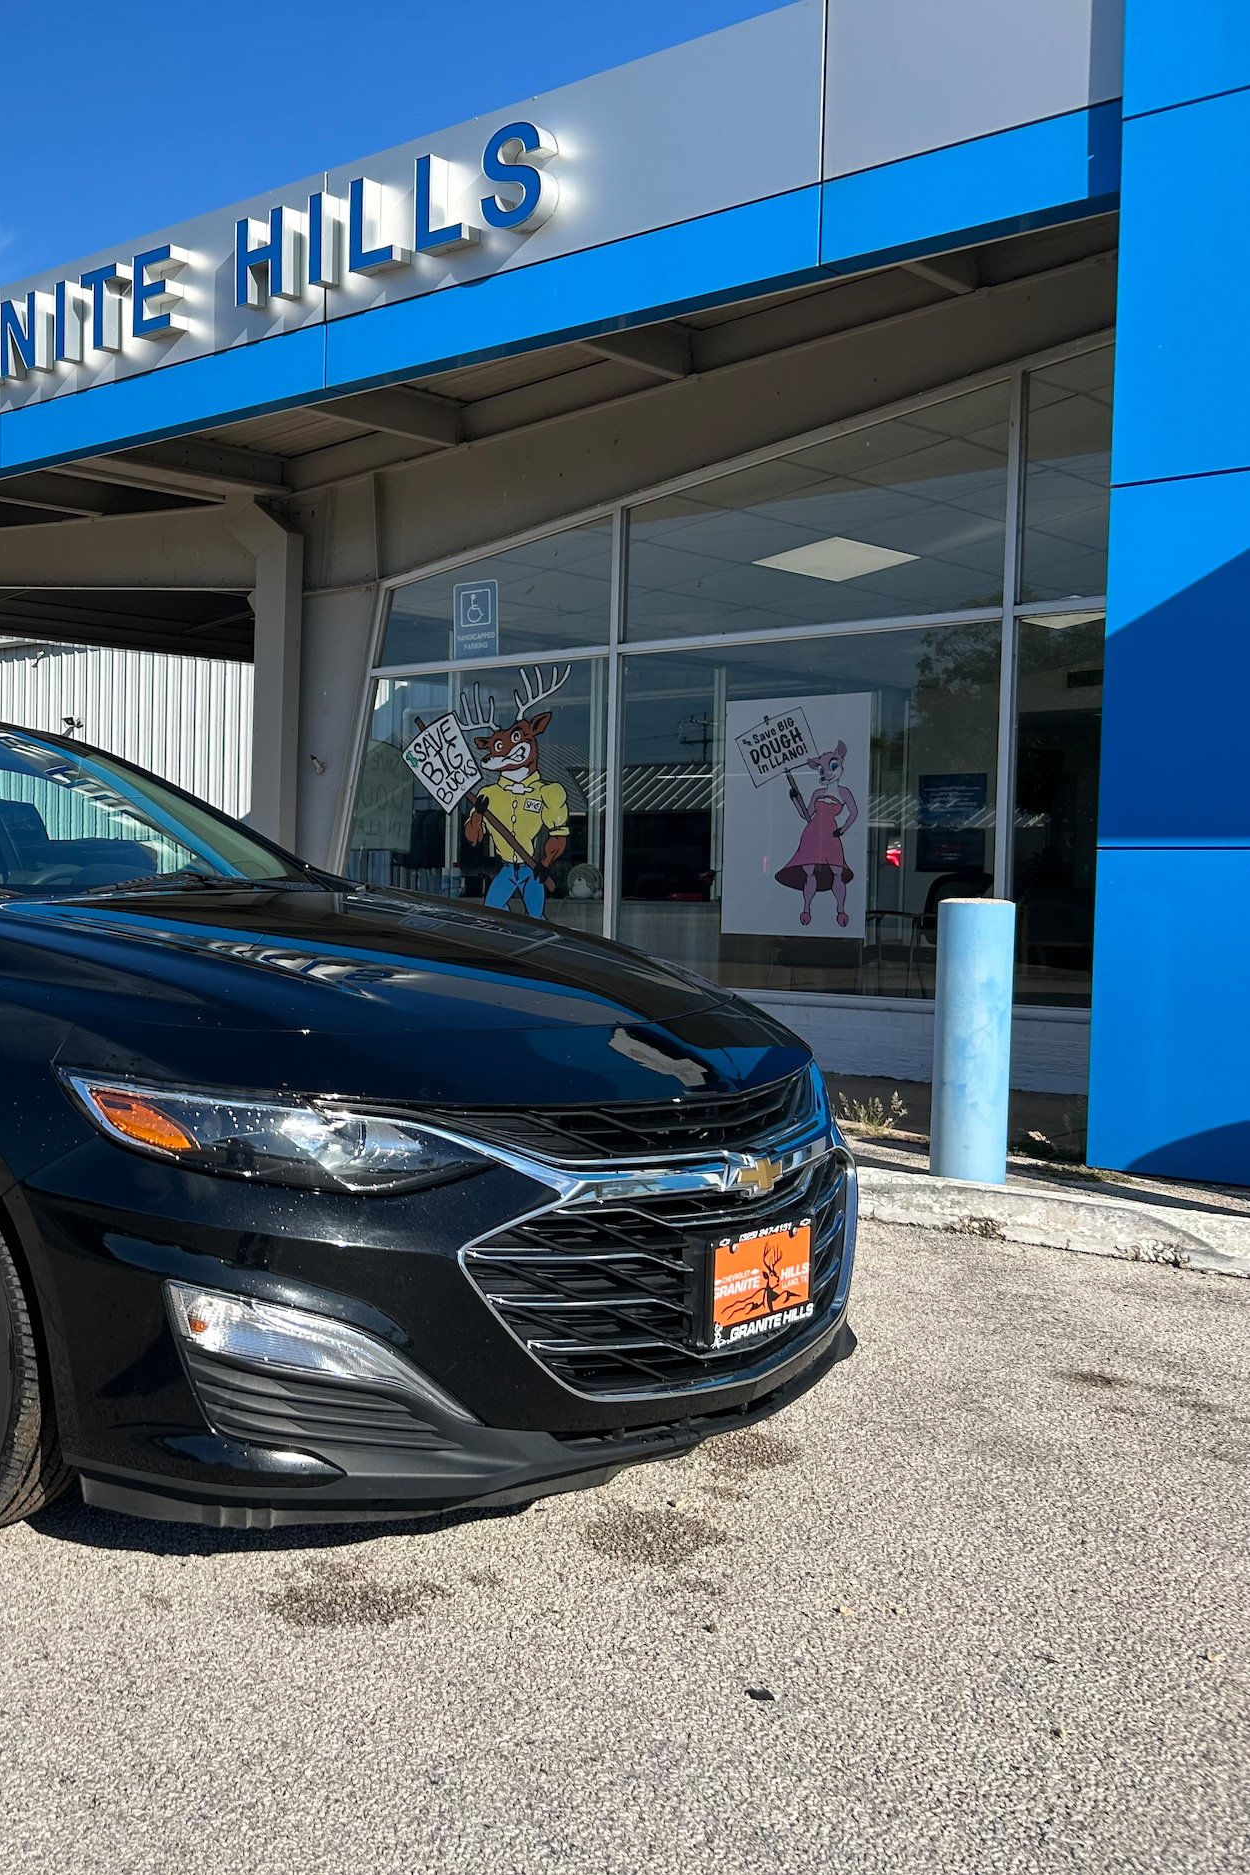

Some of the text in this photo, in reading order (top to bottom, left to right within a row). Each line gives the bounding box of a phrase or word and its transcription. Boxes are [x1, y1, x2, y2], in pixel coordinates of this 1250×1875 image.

[235, 121, 558, 308] HILLS
[456, 631, 496, 642] HANDICAPPED
[463, 641, 488, 651] PARKING
[413, 718, 457, 762] SAVE
[750, 727, 803, 764] DOUGH
[752, 718, 794, 744] Save BIG
[421, 742, 463, 786] BIG
[770, 743, 808, 768] LLANO!
[436, 759, 478, 805] BUCKS
[721, 1269, 750, 1284] CHEVROLET
[781, 1262, 810, 1280] HILLS
[730, 1302, 814, 1343] GRANITE HILLS
